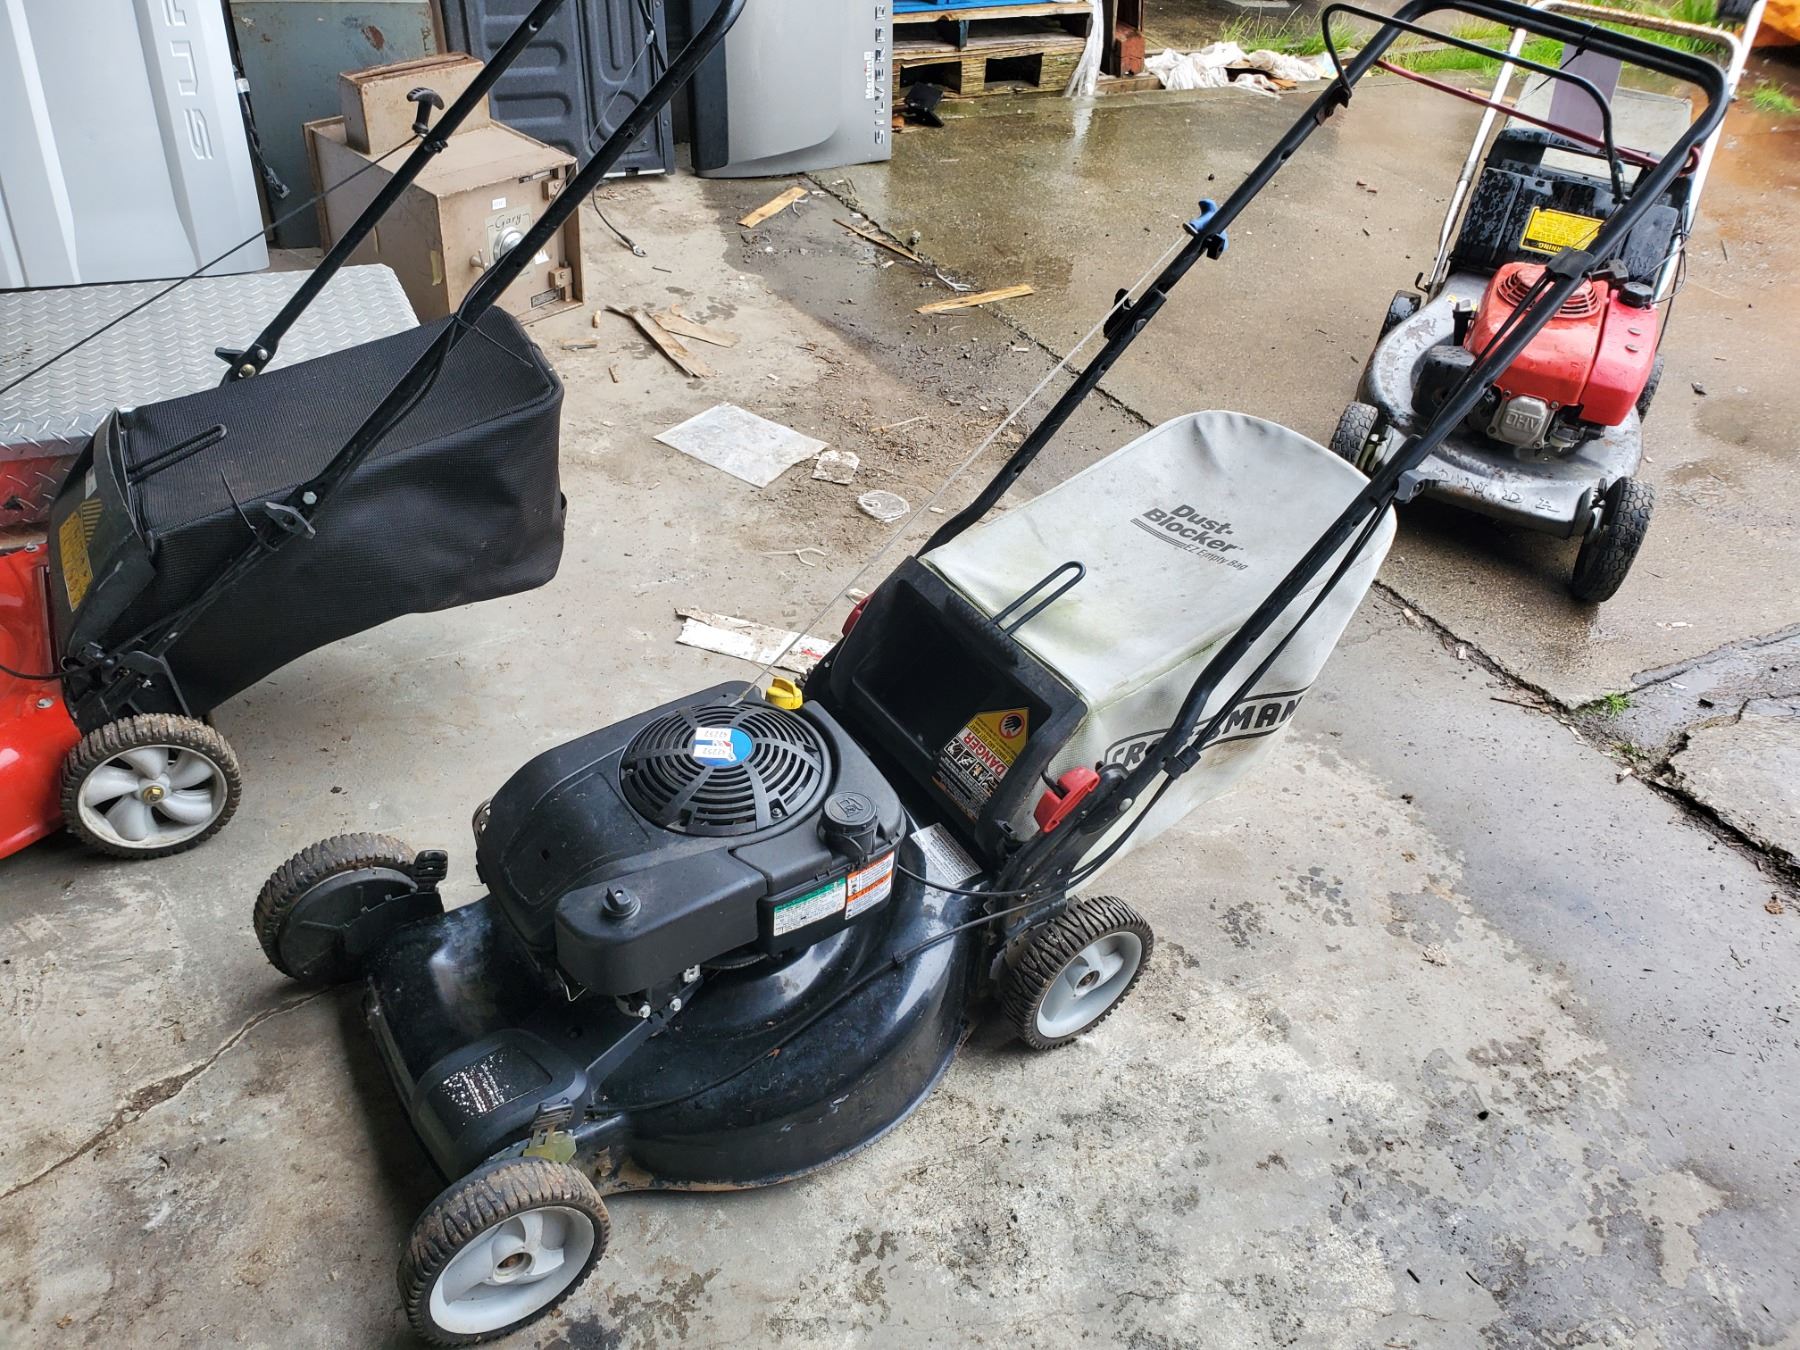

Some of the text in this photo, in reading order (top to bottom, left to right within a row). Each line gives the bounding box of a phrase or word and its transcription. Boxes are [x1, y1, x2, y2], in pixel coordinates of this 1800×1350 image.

[495, 213, 521, 230] Gary
[1505, 413, 1539, 432] OHV
[1142, 507, 1238, 552] Blocker
[1170, 504, 1234, 535] Dust-
[1183, 543, 1248, 571] EZ Empty Bag
[963, 731, 1007, 777] DANGER
